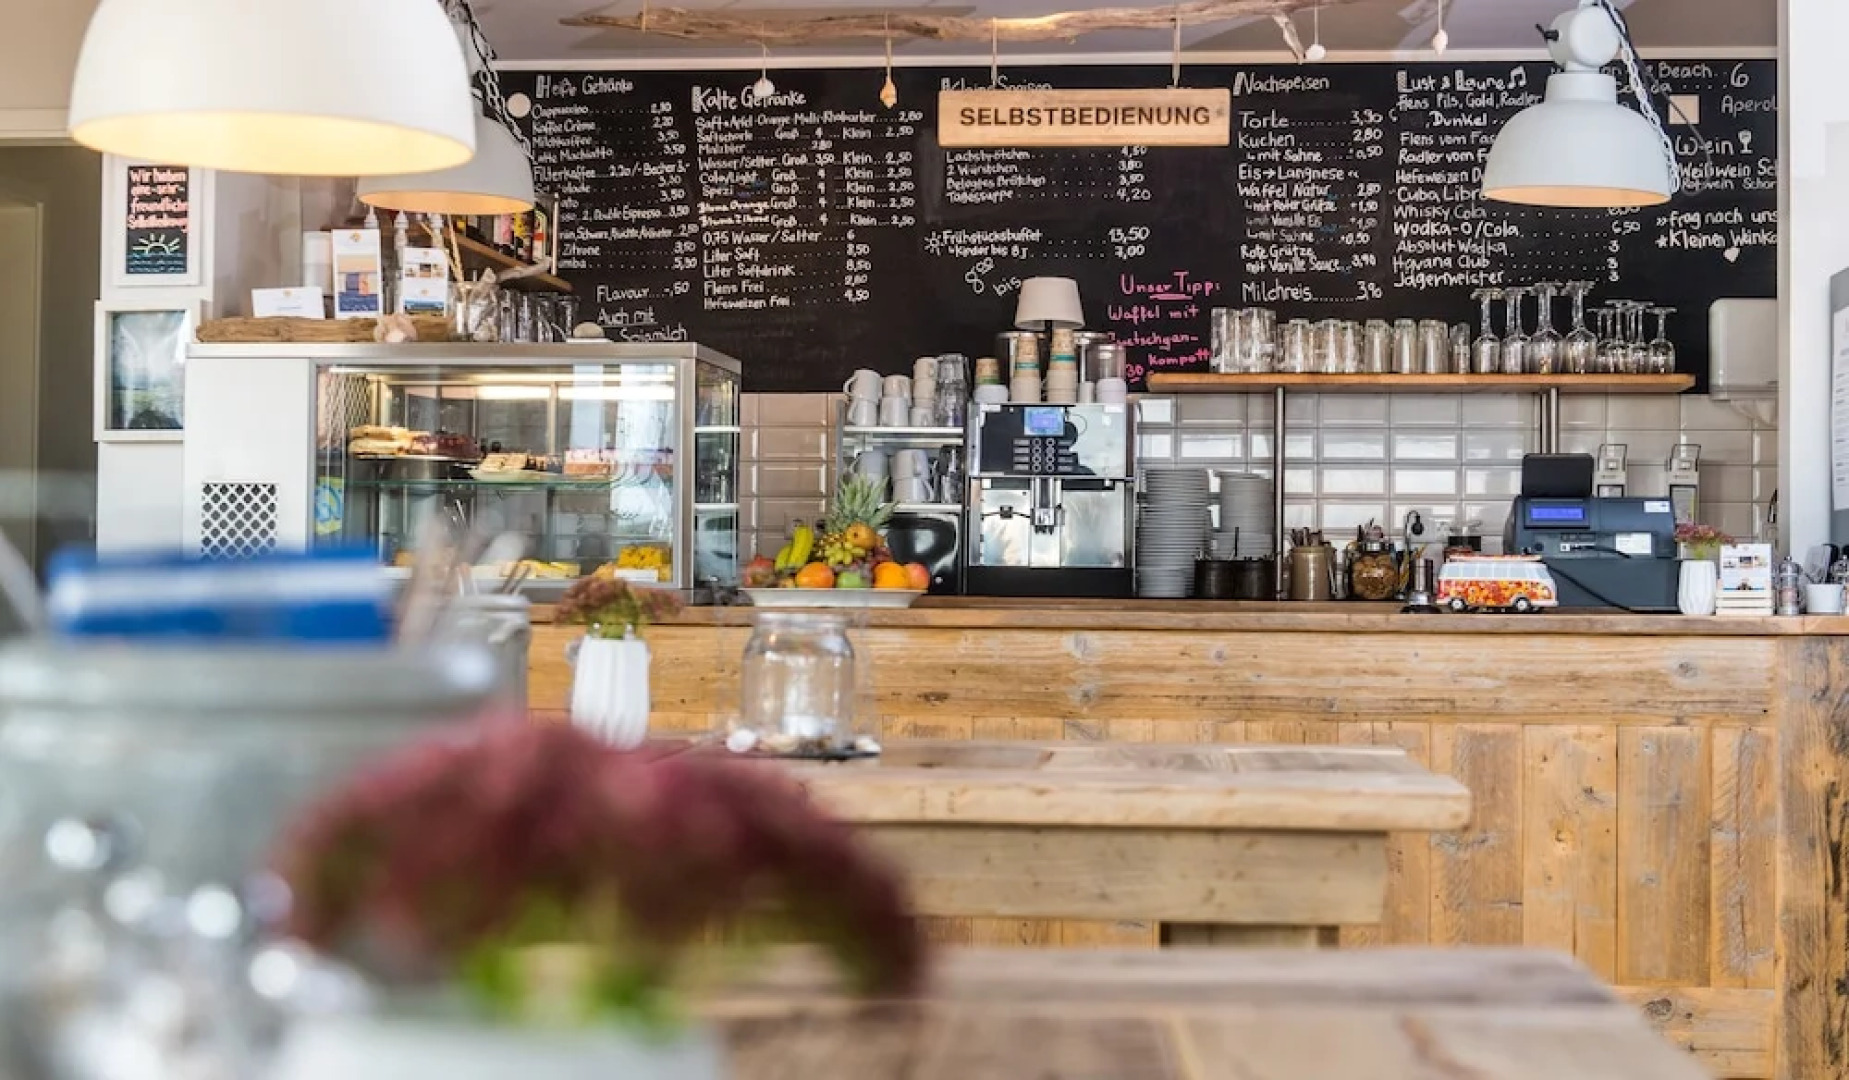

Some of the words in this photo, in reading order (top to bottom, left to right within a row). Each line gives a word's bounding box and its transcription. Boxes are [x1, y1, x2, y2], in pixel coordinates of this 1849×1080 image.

[1233, 71, 1331, 96] Nachspeisen
[1397, 69, 1436, 93] Lust
[1454, 69, 1506, 92] Laune
[1658, 61, 1713, 79] Beach
[1729, 62, 1750, 88] 6
[692, 85, 738, 113] Kalte
[960, 106, 1211, 126] SELBSTBEDIENUNG
[1239, 108, 1290, 128] Torte
[1239, 130, 1295, 149] Kuchen
[1400, 132, 1434, 146] Flens
[842, 150, 873, 165] Klein
[1398, 147, 1444, 165] Radler
[1445, 151, 1475, 163] vom
[844, 165, 874, 180] Klein
[846, 180, 876, 194] Klein
[1237, 182, 1288, 198] Waffel
[1393, 204, 1450, 221] Whisky
[1453, 202, 1487, 219] Cola
[1705, 207, 1743, 224] nach
[703, 247, 733, 264] Liter
[734, 246, 760, 262] Saft
[1392, 255, 1452, 274] Havana
[1457, 254, 1491, 269] Club
[703, 263, 733, 279] Liter
[1242, 278, 1313, 302] Milchreis
[599, 306, 630, 325] Auch
